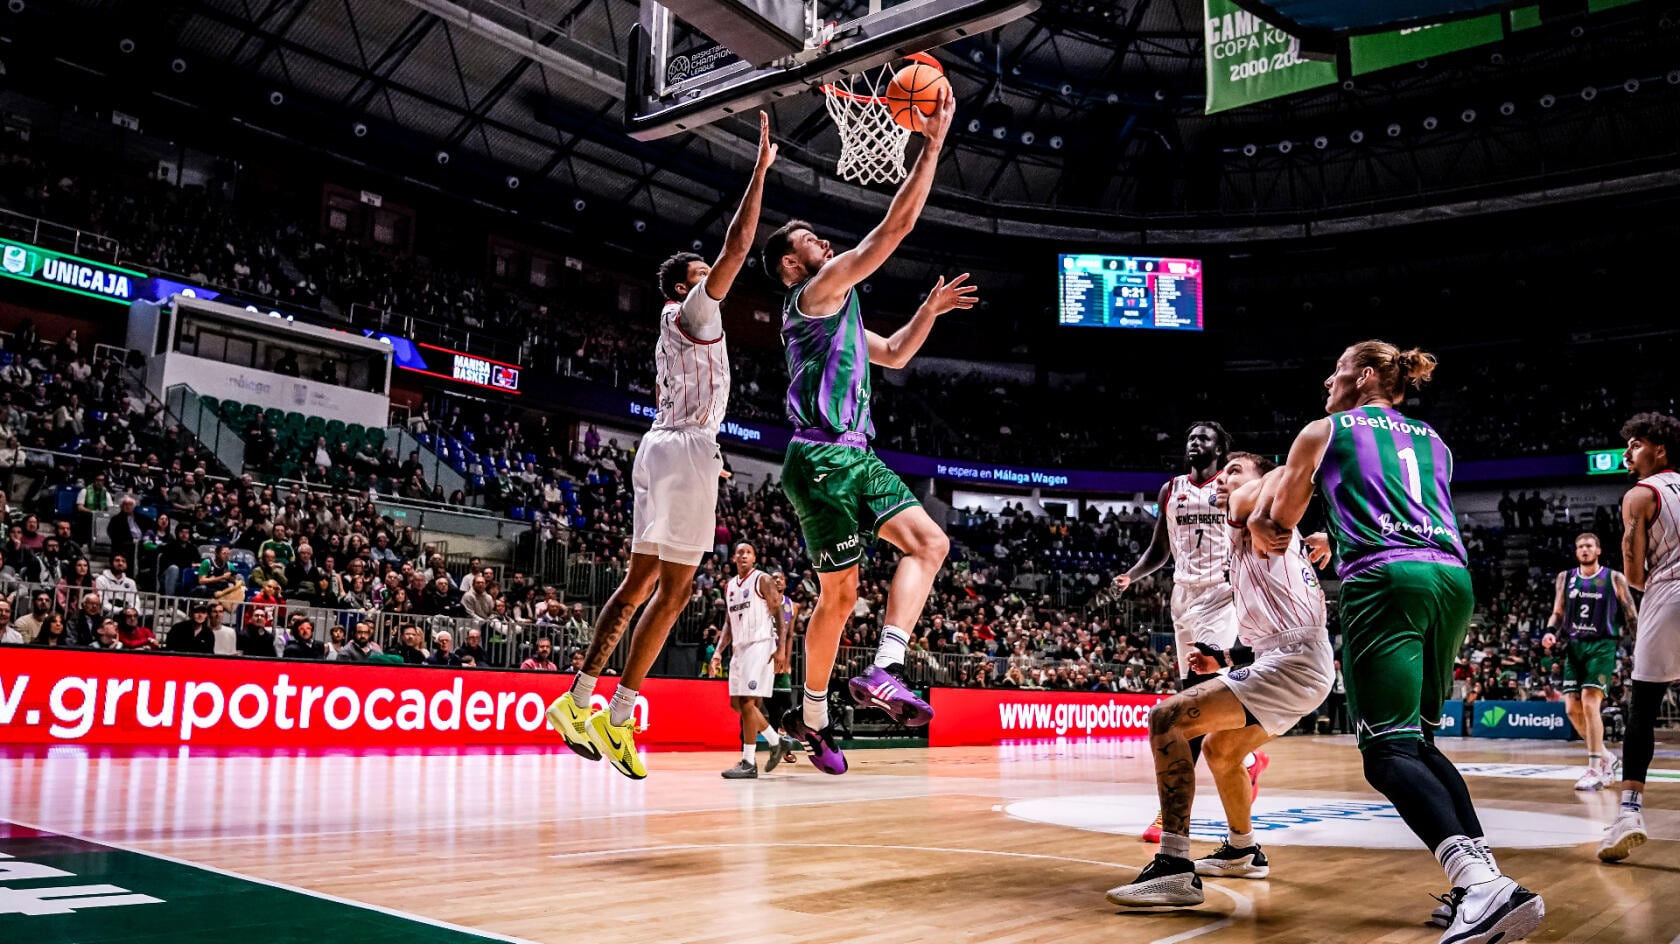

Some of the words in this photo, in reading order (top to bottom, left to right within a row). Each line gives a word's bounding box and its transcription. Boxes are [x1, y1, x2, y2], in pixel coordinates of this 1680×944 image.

[1208, 9, 1274, 45] CAMP
[1213, 35, 1260, 59] COPA
[1263, 28, 1296, 46] KO
[690, 62, 715, 76] LEAGUE
[691, 49, 734, 69] CHAMPION
[1230, 52, 1309, 82] 2000/20
[43, 258, 129, 298] UNICAJA
[454, 354, 490, 374] MANISA
[453, 366, 490, 385] BASKET
[630, 402, 640, 414] te
[728, 421, 761, 441] Wagen
[937, 464, 947, 475] te
[948, 465, 978, 479] espera
[980, 469, 992, 479] en
[993, 469, 1029, 484] Málaga
[1031, 471, 1068, 487] Wagen
[1397, 448, 1422, 504] 1
[1195, 529, 1204, 549] 7
[1580, 604, 1590, 618] 2
[999, 698, 1160, 735] www.grupotroca
[1508, 713, 1564, 730] Unicaja
